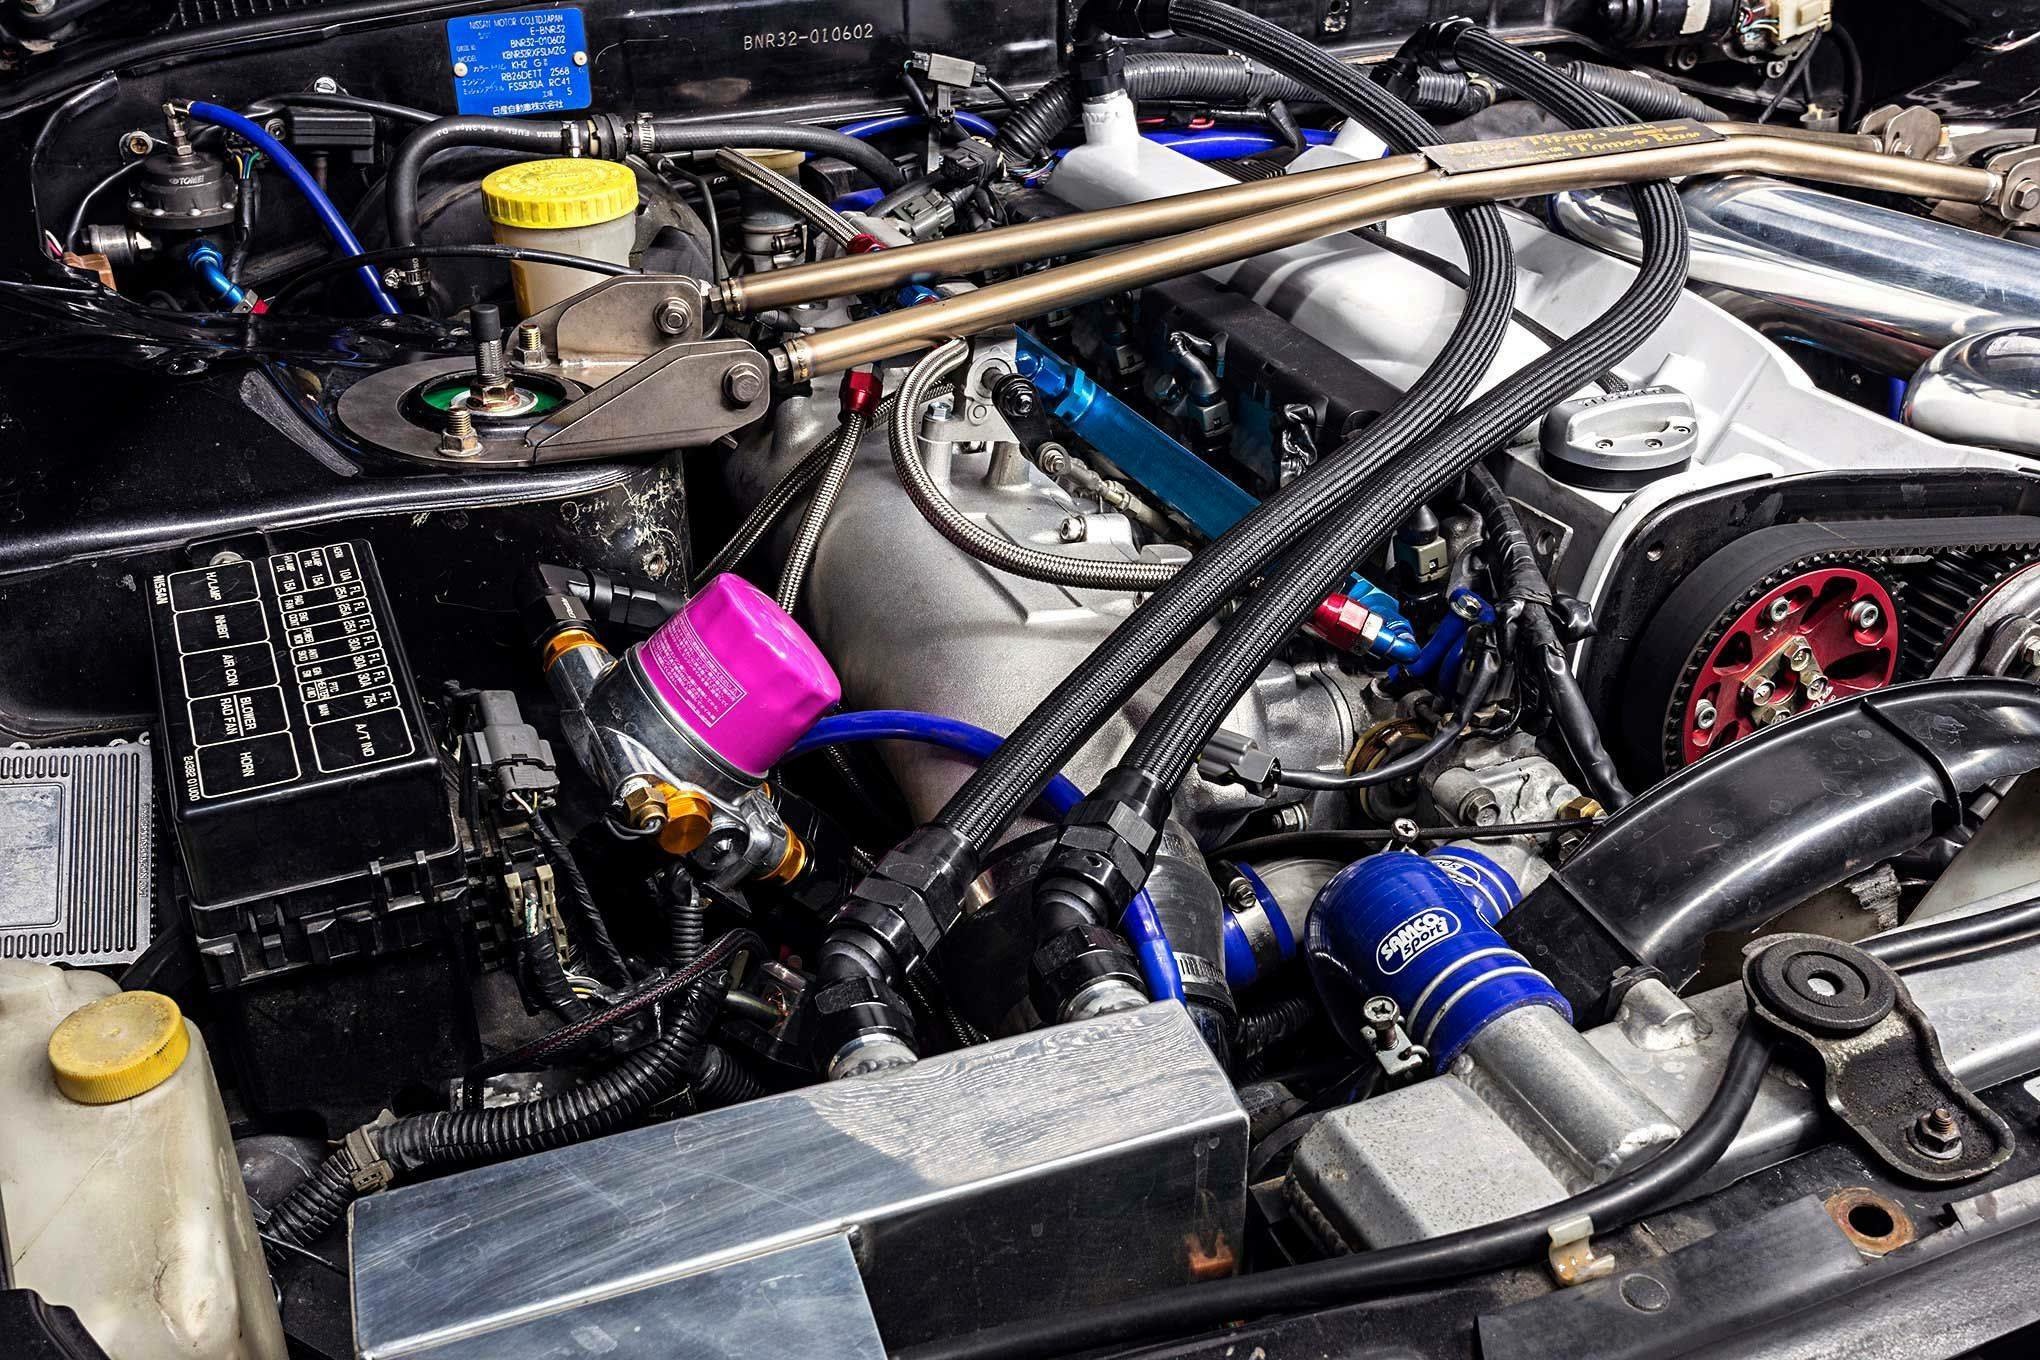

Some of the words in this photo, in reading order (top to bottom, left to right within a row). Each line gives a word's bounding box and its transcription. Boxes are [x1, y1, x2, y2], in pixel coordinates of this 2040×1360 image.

[530, 25, 566, 35] E-BNR32
[743, 23, 873, 51] BNR32-010602
[501, 69, 542, 81] RB26DETT
[550, 67, 570, 77] 2568
[508, 79, 544, 91] FS5R30A
[548, 77, 571, 87] RC41
[312, 573, 325, 587] 15A
[339, 568, 353, 581] 10A
[153, 574, 169, 605] NISSAN
[206, 571, 222, 601] H/LAMP
[282, 578, 296, 592] 15A
[349, 585, 361, 596] FL
[334, 586, 348, 600] 25A
[338, 603, 352, 617] 25A
[353, 601, 366, 612] FL
[214, 614, 230, 639] INHIBIT
[343, 619, 357, 634] 25A
[358, 618, 371, 629] FL
[347, 637, 362, 652] 30A
[361, 635, 375, 647] FL
[222, 654, 236, 668] AIR
[352, 654, 367, 670] 30A
[367, 652, 381, 665] FL
[225, 668, 239, 687] CON
[358, 672, 372, 688] 30A
[372, 670, 386, 682] FL
[362, 692, 378, 709] 75A
[378, 691, 392, 703] FL
[220, 697, 234, 716] RAD
[240, 696, 257, 731] BLOWER
[223, 716, 238, 736] FAN
[355, 723, 371, 741] A/T
[361, 741, 375, 757] IND
[183, 755, 197, 778] 24382
[240, 751, 255, 778] HORN
[1380, 912, 1441, 962] SAMCO
[1403, 922, 1444, 954] sport
